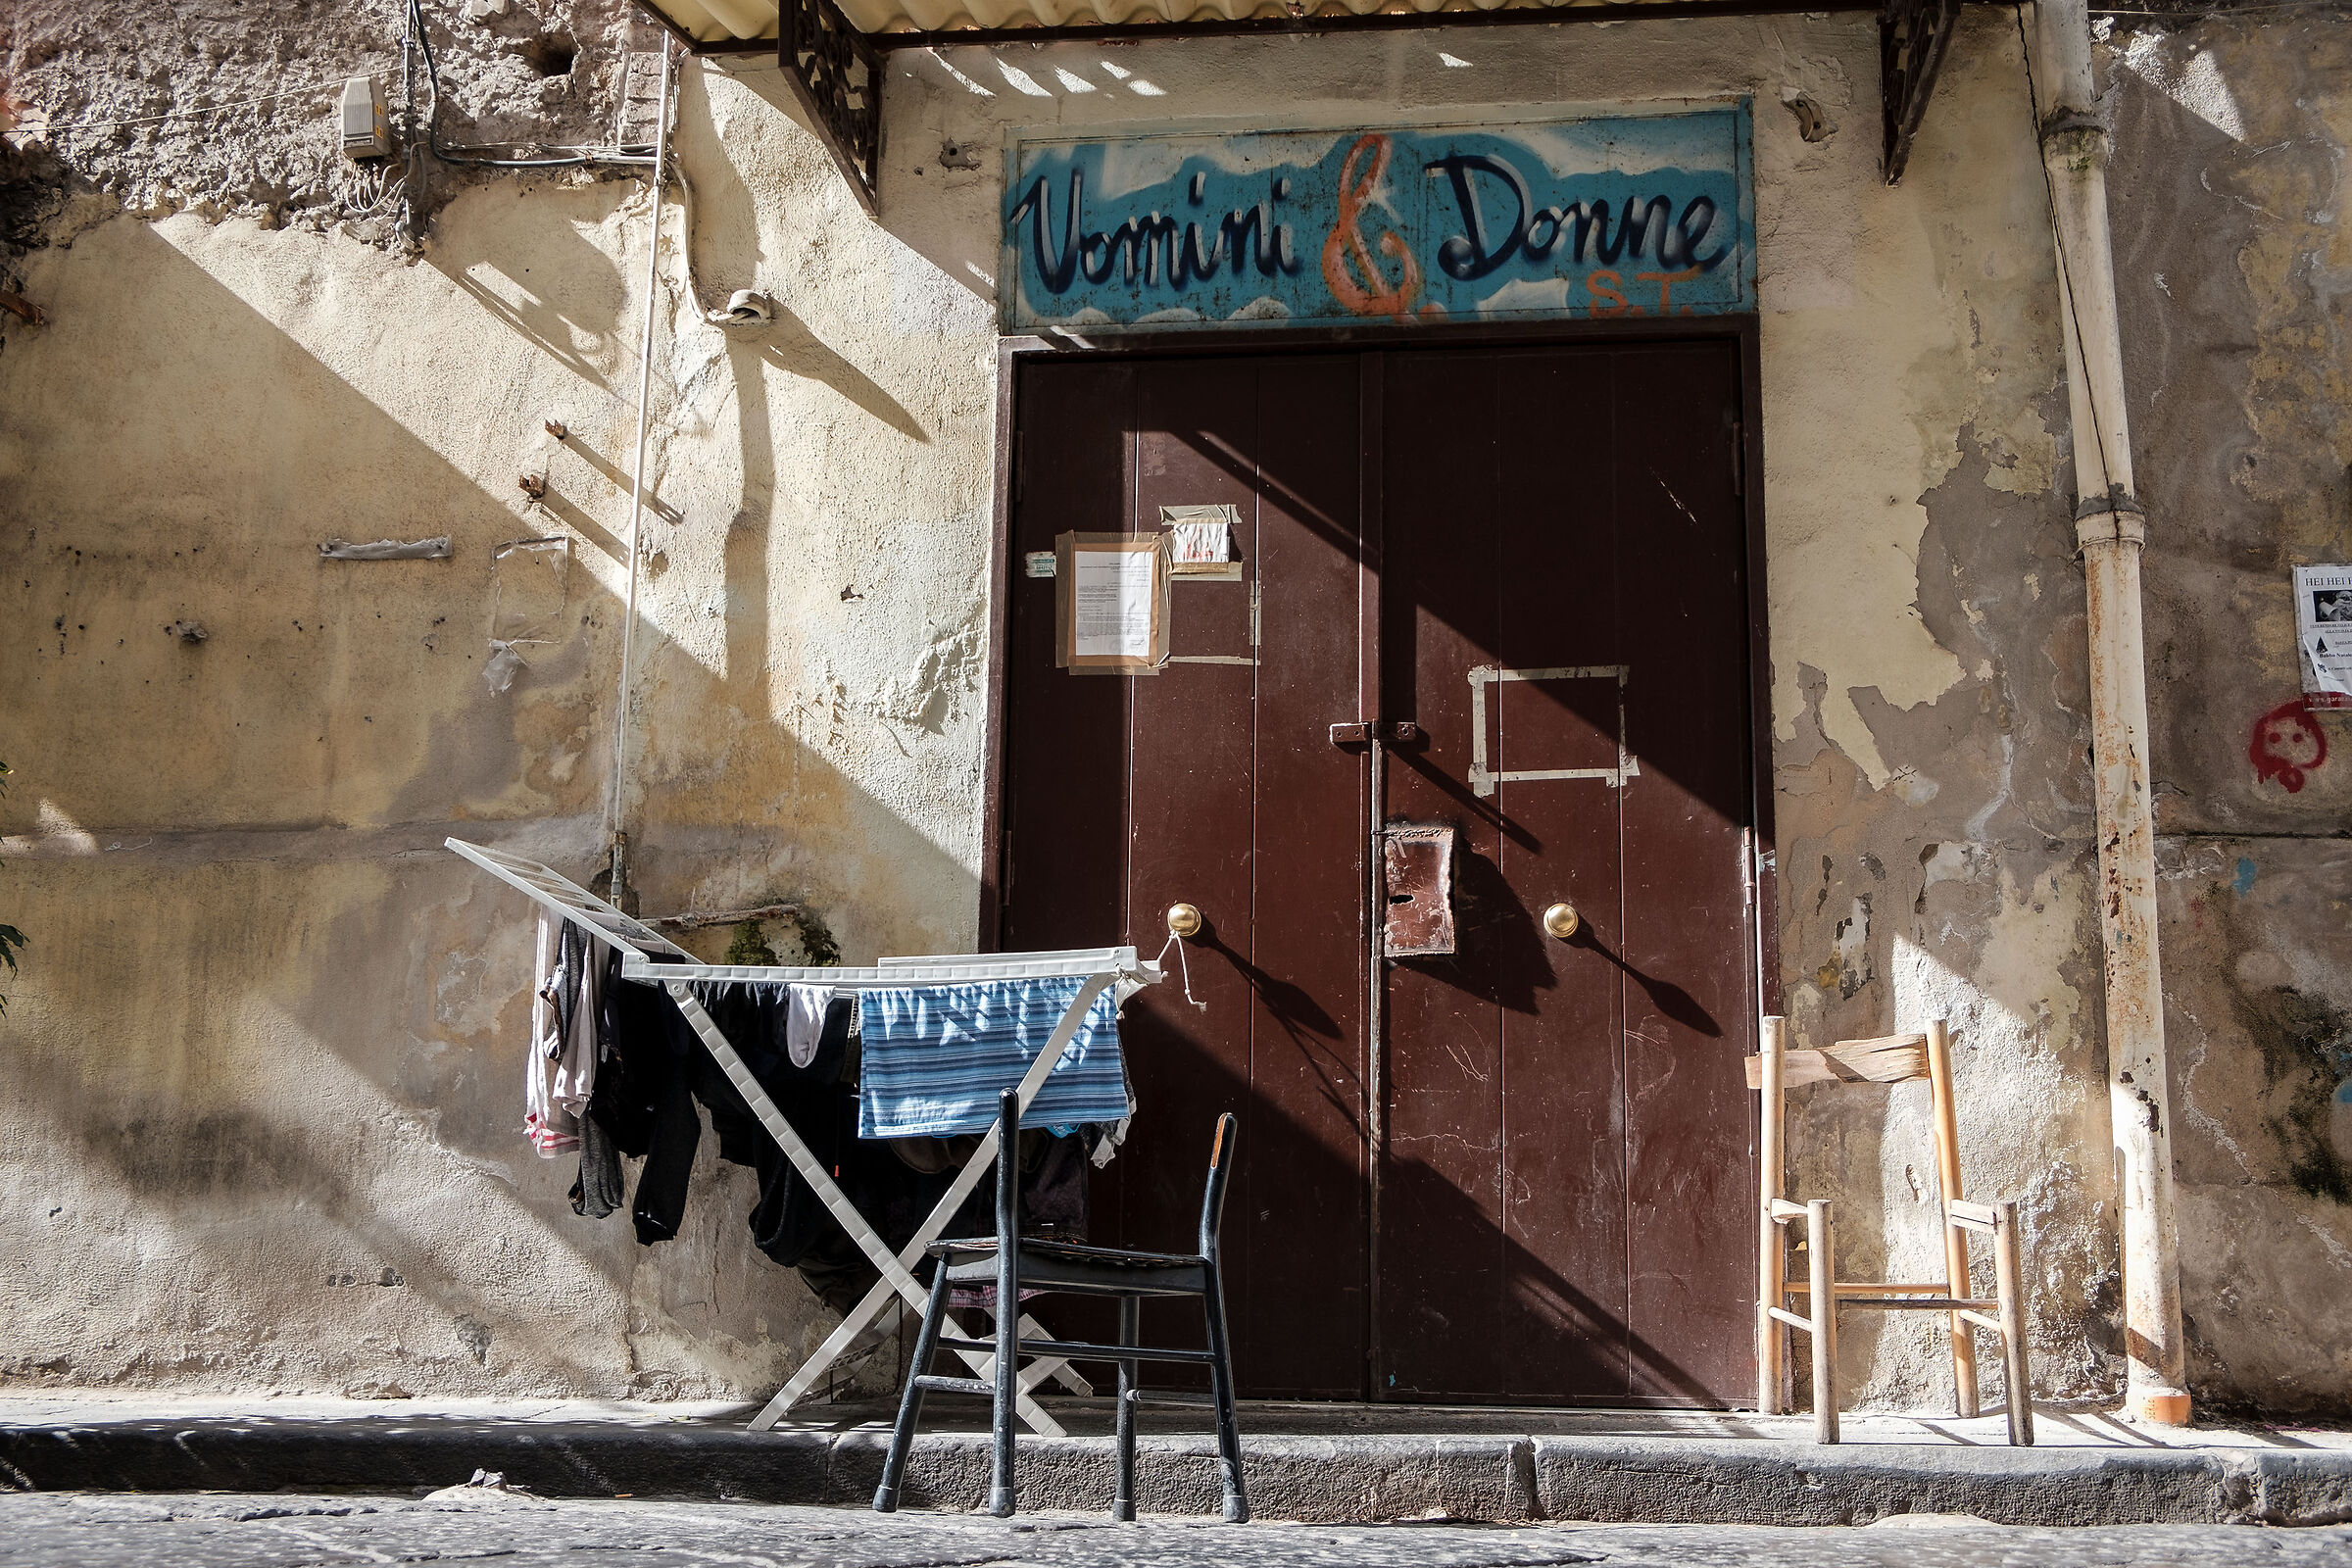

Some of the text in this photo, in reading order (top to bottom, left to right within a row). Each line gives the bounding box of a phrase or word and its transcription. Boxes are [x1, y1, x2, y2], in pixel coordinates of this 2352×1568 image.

[1424, 153, 1732, 281] Donne
[2305, 577, 2324, 586] HEI
[2327, 577, 2345, 586] HEI
